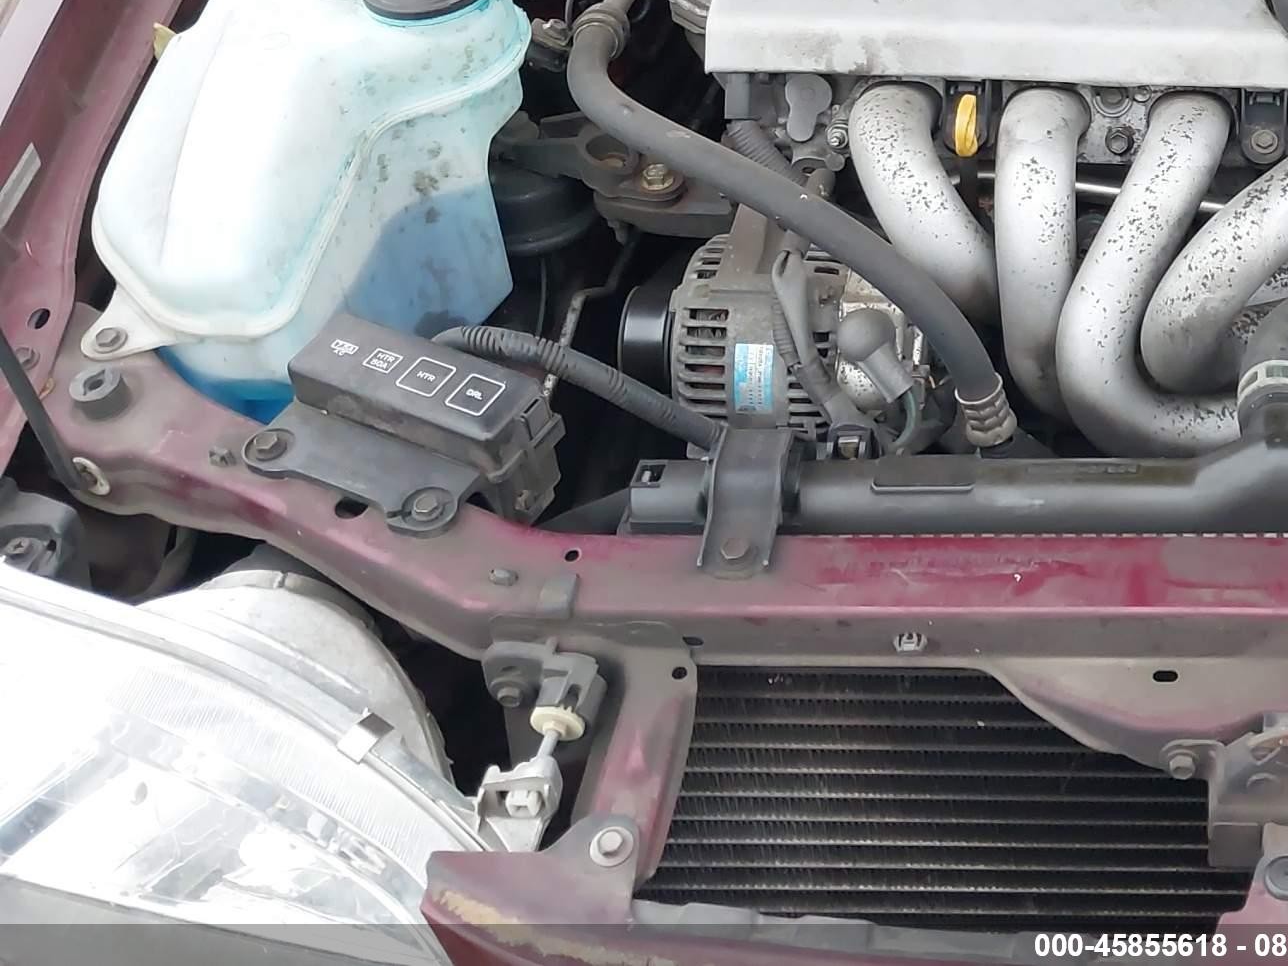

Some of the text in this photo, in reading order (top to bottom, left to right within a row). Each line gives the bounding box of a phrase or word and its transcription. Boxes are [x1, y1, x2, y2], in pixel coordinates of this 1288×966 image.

[377, 352, 396, 363] HTR
[416, 370, 437, 383] HTR
[465, 388, 484, 401] DRL
